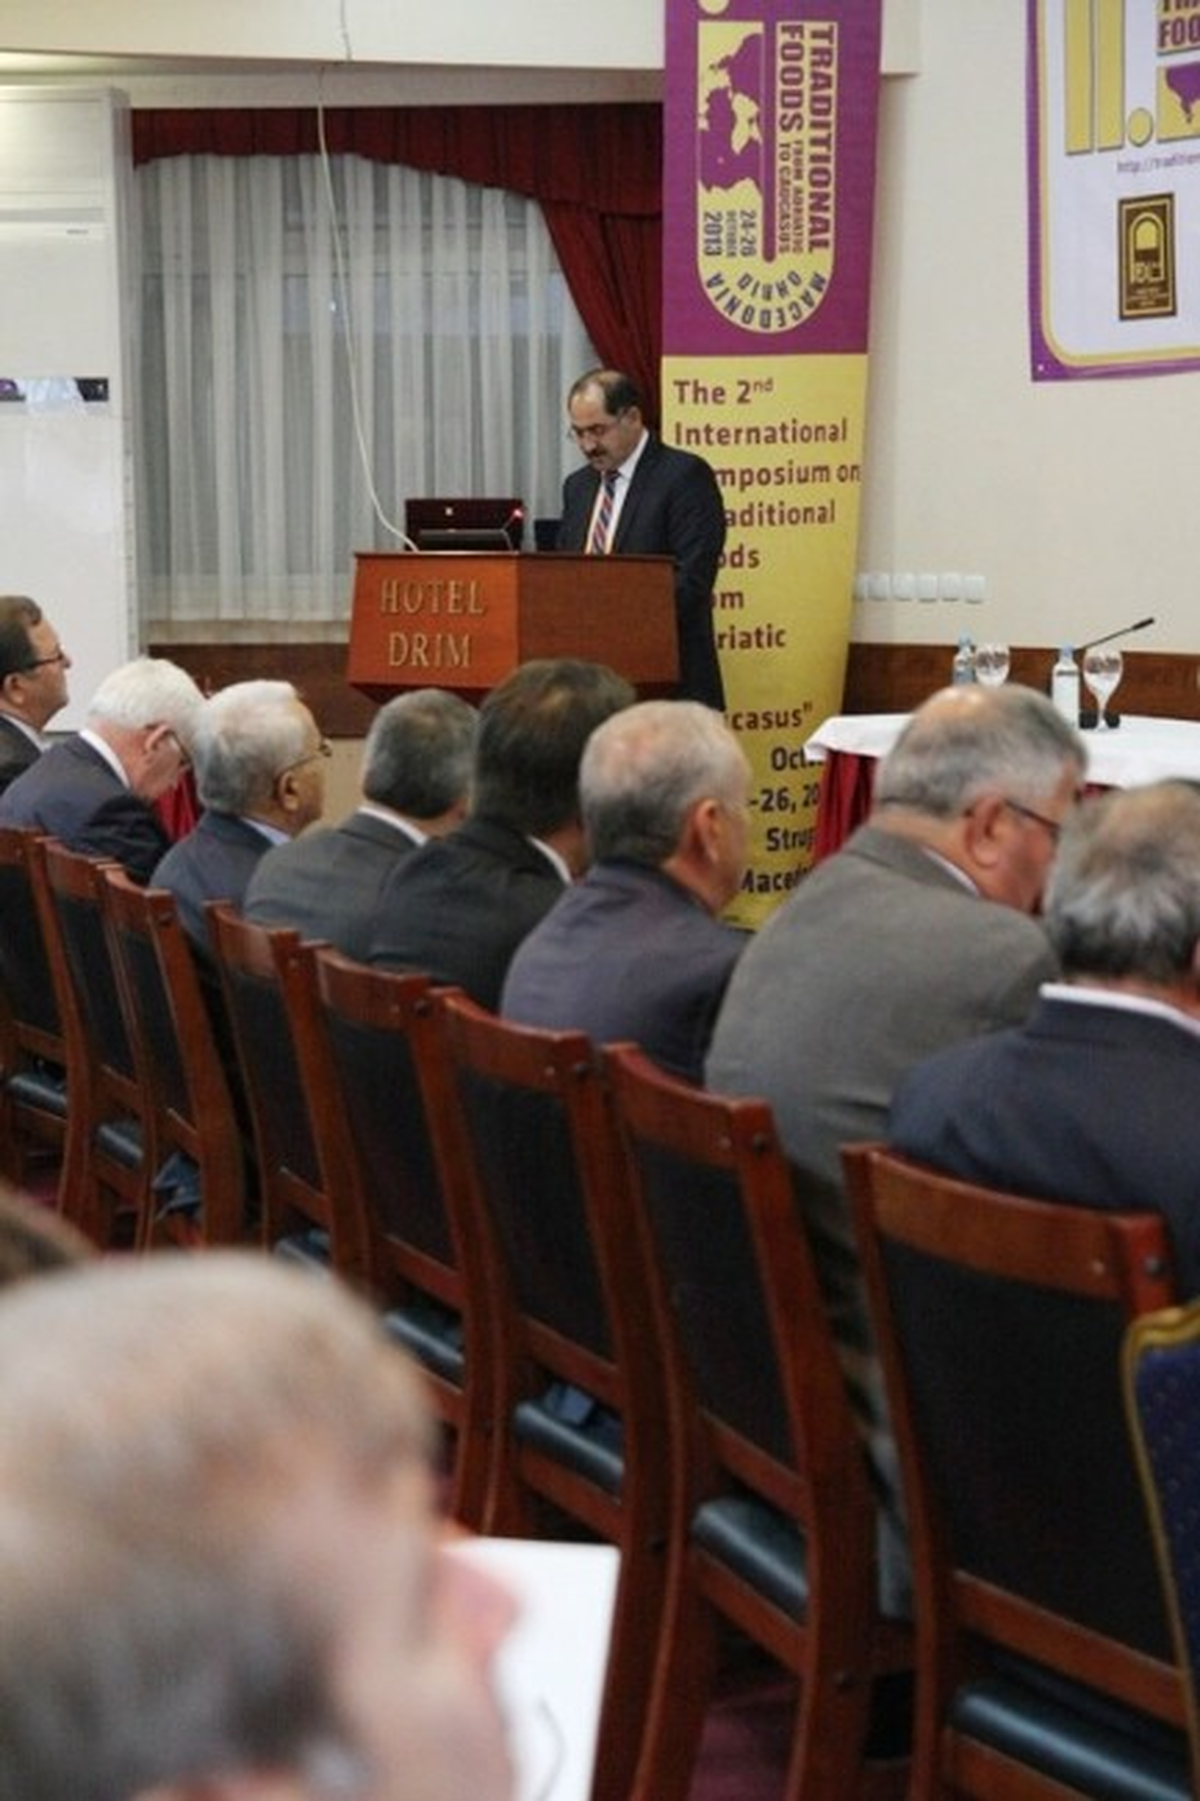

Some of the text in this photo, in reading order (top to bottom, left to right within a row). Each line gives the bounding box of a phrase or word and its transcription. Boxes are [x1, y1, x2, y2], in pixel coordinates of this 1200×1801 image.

[1158, 13, 1200, 48] FOO
[779, 25, 805, 133] FOODS
[808, 24, 835, 254] TRADITIONAL
[779, 142, 791, 254] TO CAUCASUS
[703, 211, 723, 257] 2013
[739, 209, 758, 258] 24-26
[706, 271, 827, 329] MACEDONIA
[673, 377, 774, 405] The 2nd
[674, 416, 847, 446] International
[714, 459, 861, 493] mposium on
[724, 498, 835, 528] aditional
[380, 578, 486, 614] HOTEL
[389, 630, 470, 668] DRIM
[717, 623, 787, 650] riatic
